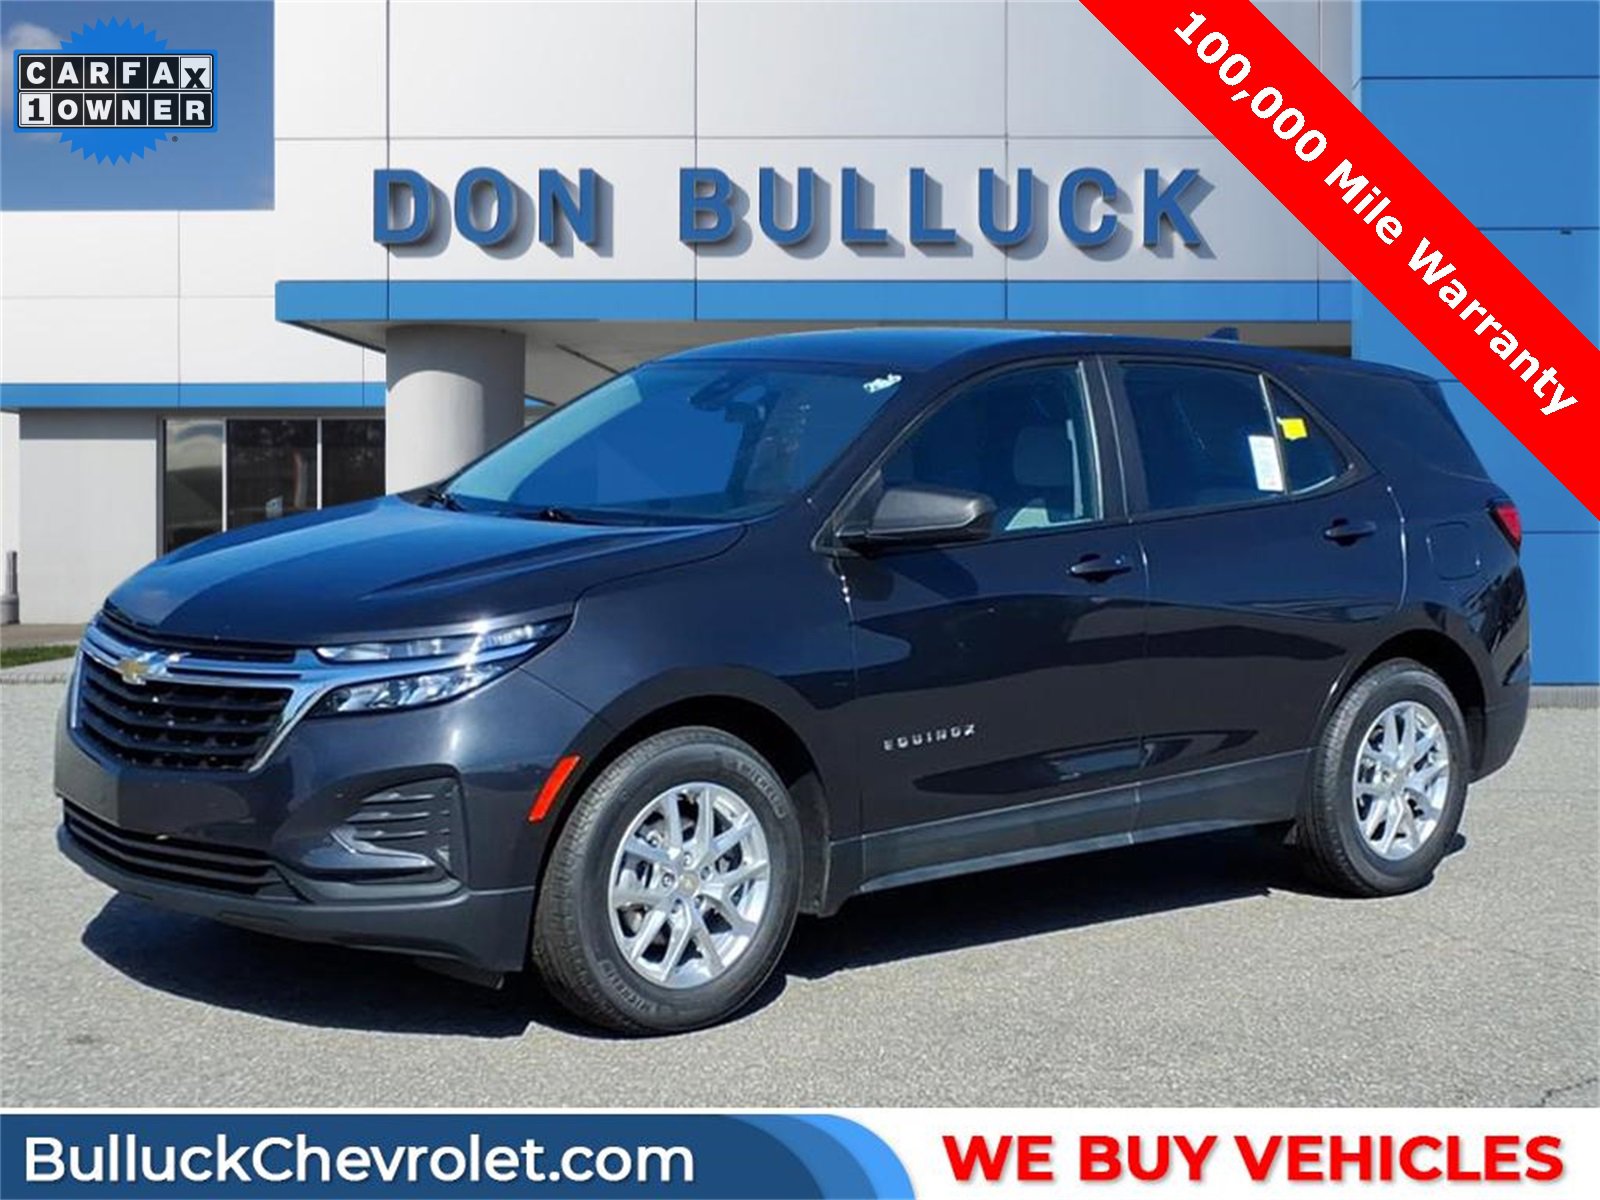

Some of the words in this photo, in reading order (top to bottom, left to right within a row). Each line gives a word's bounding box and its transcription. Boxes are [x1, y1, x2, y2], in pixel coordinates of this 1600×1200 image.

[373, 167, 598, 247] DON
[679, 167, 1204, 247] BULLUCK
[883, 723, 975, 751] EQUINOX
